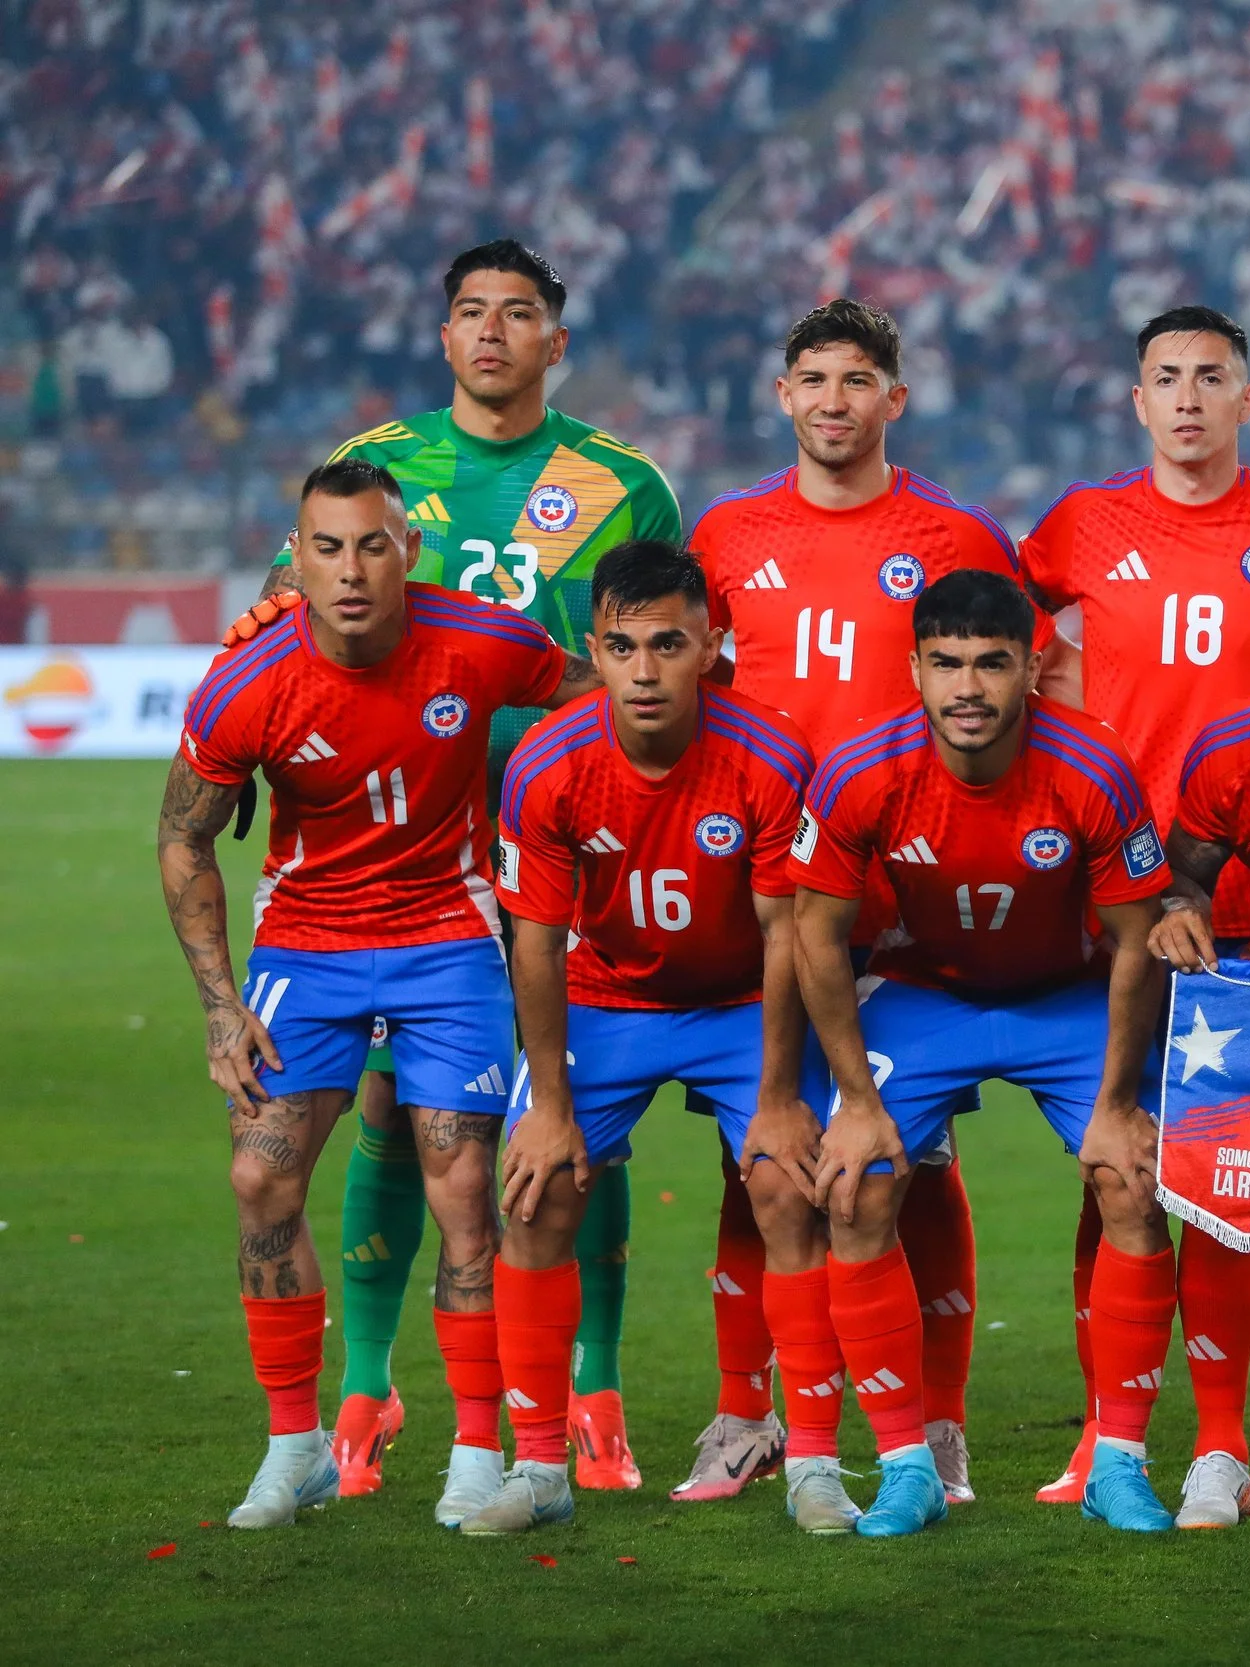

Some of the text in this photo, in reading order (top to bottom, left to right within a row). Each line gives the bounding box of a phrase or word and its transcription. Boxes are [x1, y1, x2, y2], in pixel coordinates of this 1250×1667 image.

[459, 539, 539, 611] 23
[795, 607, 856, 682] 14
[1162, 593, 1225, 666] 18
[367, 767, 407, 825] 11
[628, 869, 692, 932] 16
[956, 883, 1015, 930] 17
[1213, 1168, 1234, 1197] LA
